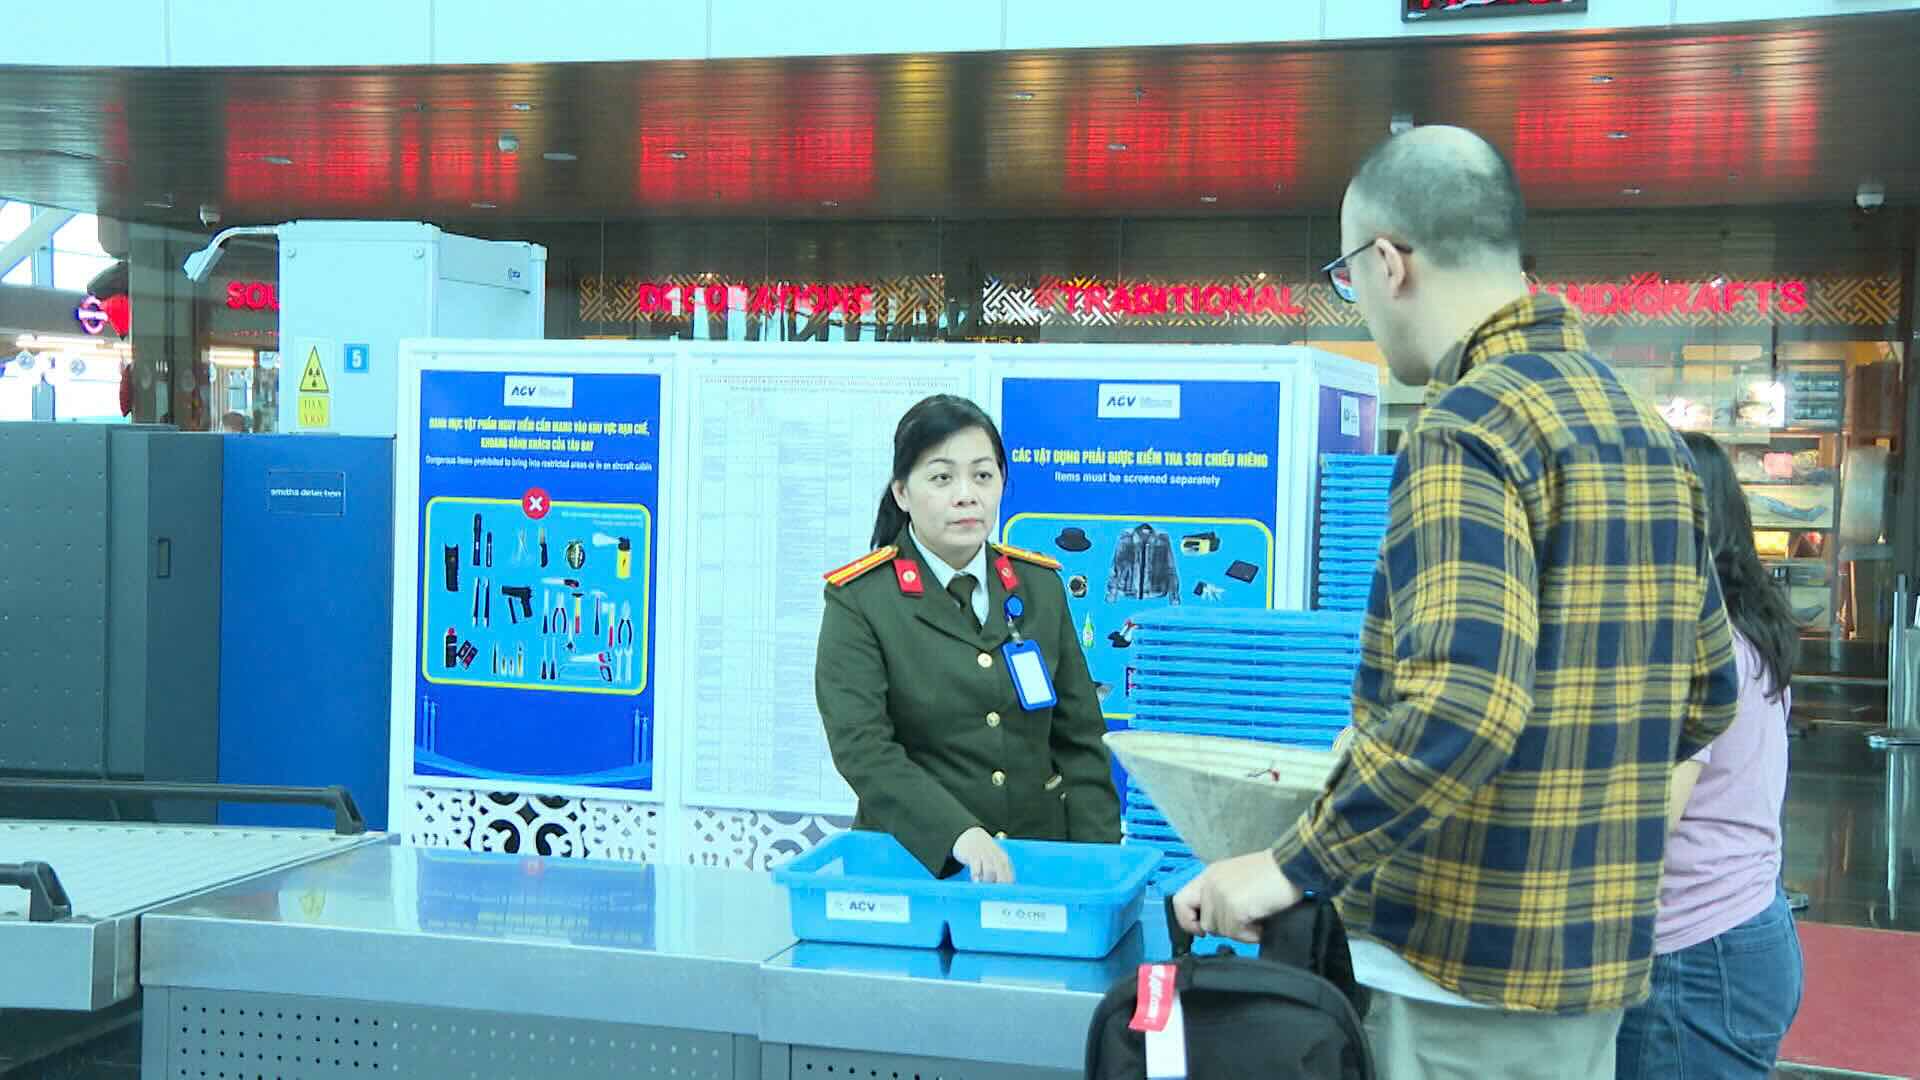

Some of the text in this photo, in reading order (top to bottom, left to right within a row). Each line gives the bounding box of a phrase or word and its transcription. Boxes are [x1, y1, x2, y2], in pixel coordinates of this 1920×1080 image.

[1063, 284, 1304, 316] TRADITIONAL
[1528, 279, 1809, 315] NDICRAFTS
[350, 348, 363, 369] 5
[511, 385, 536, 397] ACV
[1106, 395, 1137, 408] ACV
[1011, 446, 1032, 464] CÁC
[1164, 451, 1183, 466] TRA
[1184, 451, 1203, 466] SOI
[1055, 471, 1221, 488] Items must be screened separately
[848, 901, 877, 913] ACV
